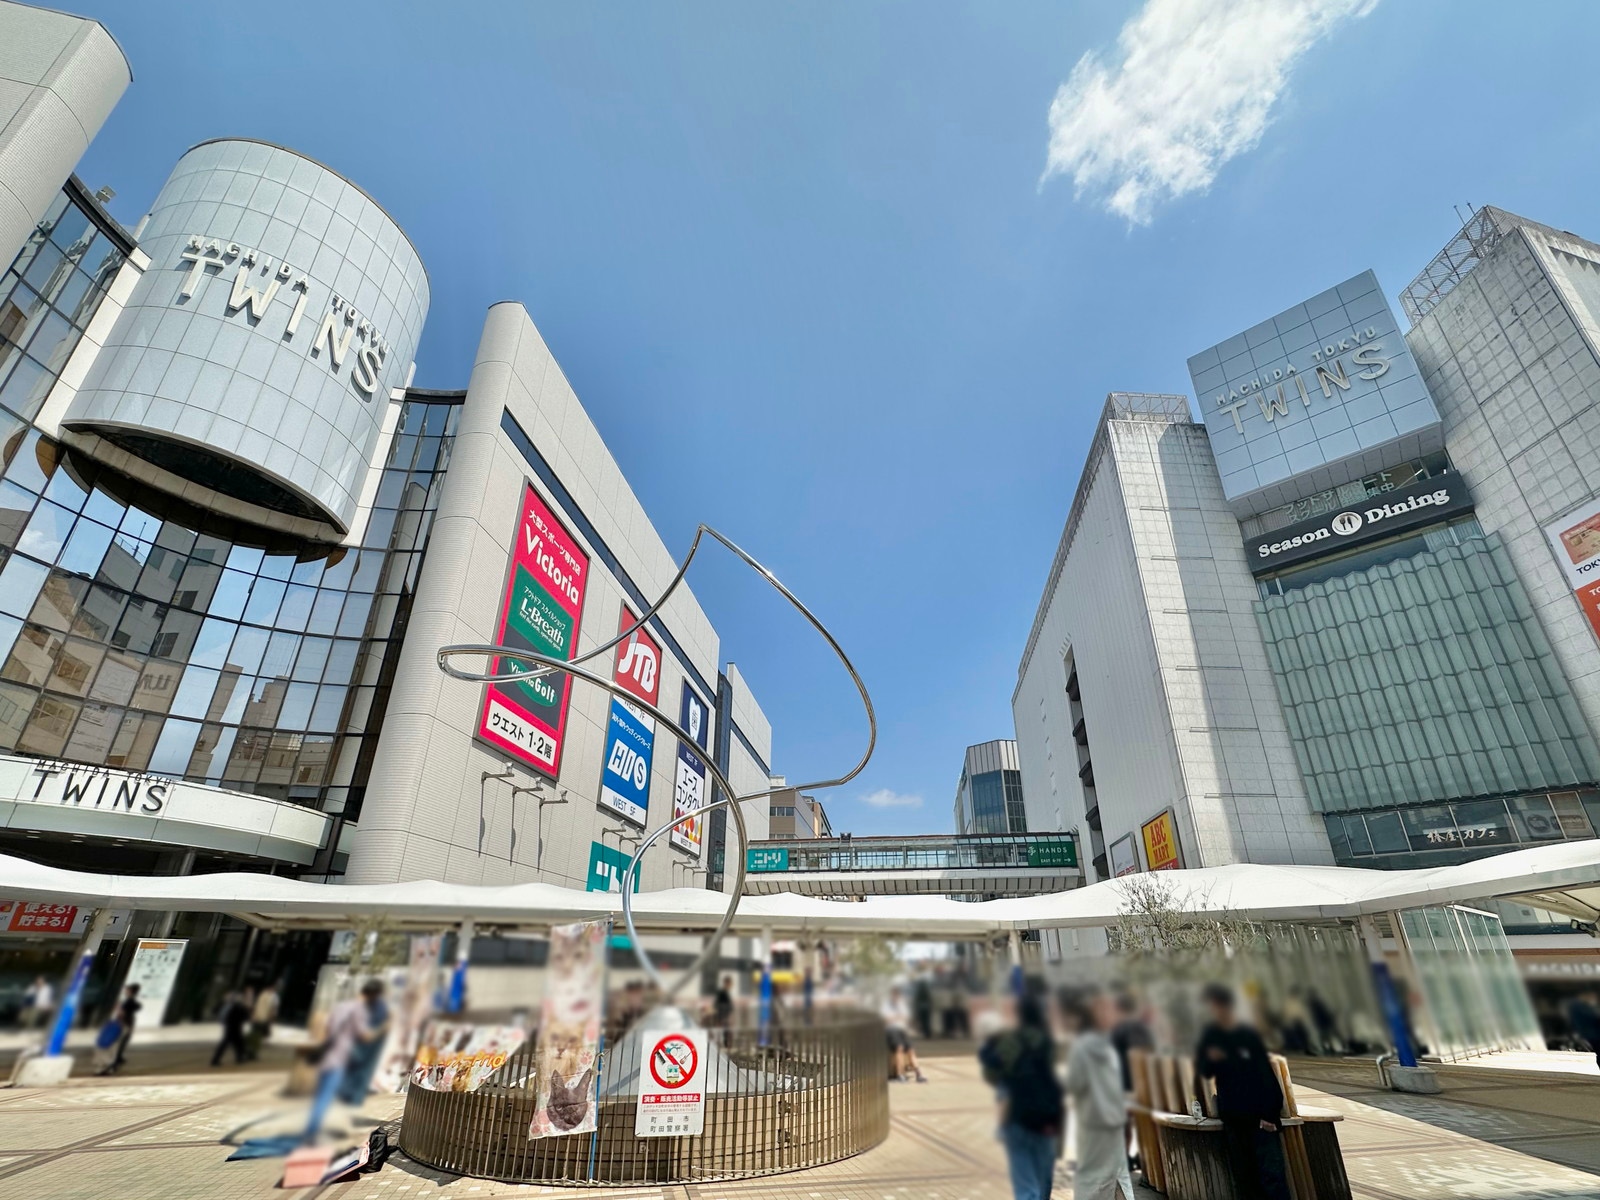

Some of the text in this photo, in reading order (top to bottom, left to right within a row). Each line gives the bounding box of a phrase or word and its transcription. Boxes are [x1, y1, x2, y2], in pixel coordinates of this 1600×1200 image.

[187, 235, 389, 353] MACHIDA TOKYU
[181, 252, 382, 393] TWINS
[1216, 325, 1377, 406] MACHIDA TOKYU
[1220, 343, 1391, 434] TWINS
[1258, 488, 1450, 558] Season Dining
[525, 523, 579, 606] Victoria
[617, 631, 657, 693] JTB
[534, 677, 555, 703] Golf
[492, 712, 525, 741] ウエスト
[37, 759, 172, 786] MACHIDA TOKYU
[683, 768, 698, 794] エース
[34, 768, 167, 812] TWINS
[612, 795, 627, 812] WEST
[676, 784, 700, 810] コンタクト
[1149, 818, 1167, 849] ABC
[754, 852, 782, 864] ニトリ
[1039, 846, 1068, 854] HANDS
[1152, 843, 1170, 865] MART
